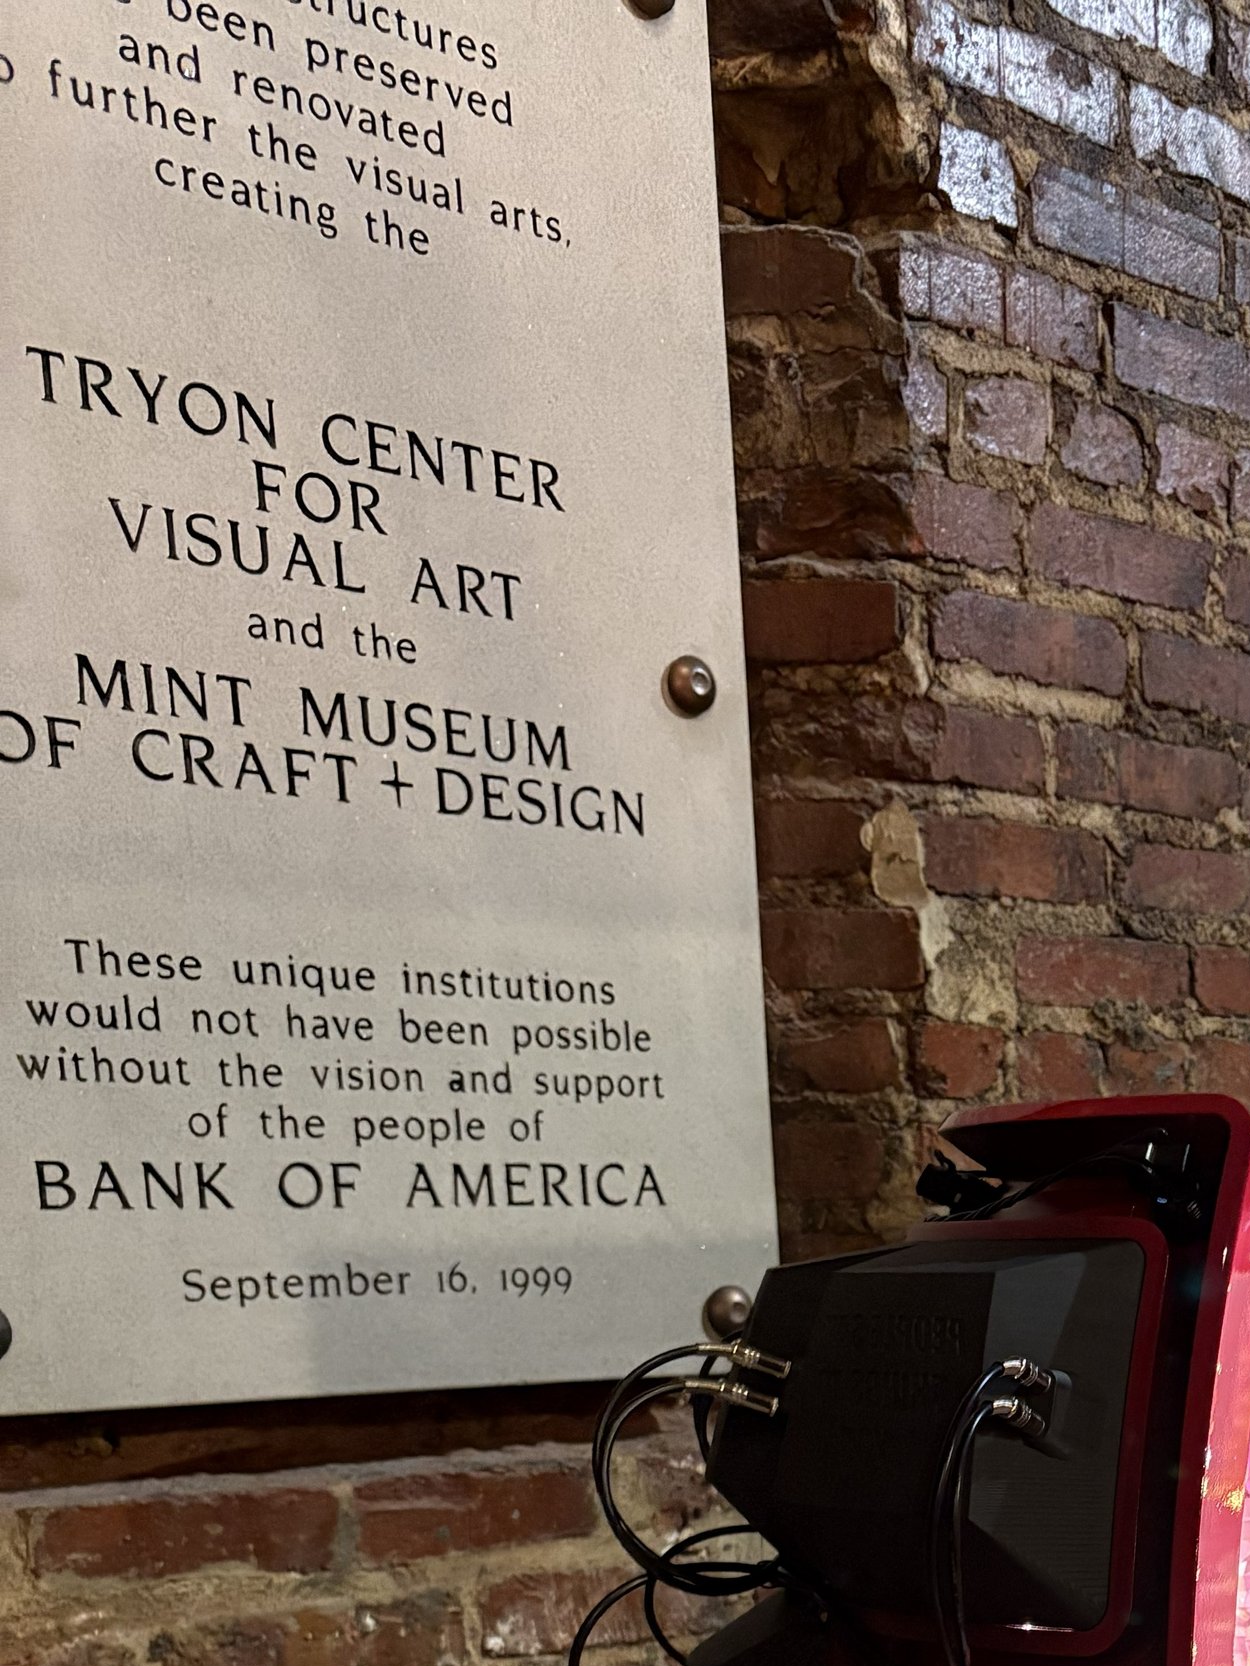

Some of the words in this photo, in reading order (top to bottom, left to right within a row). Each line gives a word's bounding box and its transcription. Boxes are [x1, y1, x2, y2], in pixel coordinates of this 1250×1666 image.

[166, 0, 276, 53] been
[305, 37, 514, 128] preserved
[287, 0, 498, 70] ructures
[118, 33, 202, 84] and
[232, 69, 446, 159] renovated
[47, 58, 218, 143] further
[247, 121, 318, 172] the
[345, 155, 464, 215] visual
[490, 199, 571, 249] arts,
[154, 157, 338, 240] creating
[364, 208, 430, 256] the
[25, 345, 277, 450] TRYON
[321, 413, 566, 513] CENTER
[251, 459, 389, 536] FOR
[107, 496, 366, 594] VISUAL
[409, 556, 522, 622] ART
[247, 612, 325, 650] and
[352, 621, 417, 665] the
[74, 652, 252, 728] MINT
[298, 686, 572, 772] MUSEUM
[0, 709, 82, 770] OF
[131, 728, 358, 804] CRAFT
[434, 766, 645, 838] DESIGN
[63, 938, 203, 982] These
[232, 954, 376, 998] unique
[401, 961, 616, 1006] institutions
[25, 993, 162, 1033] would
[191, 1007, 260, 1038] not
[286, 1003, 374, 1042] have
[398, 1007, 489, 1047] been
[512, 1017, 652, 1056] possible
[16, 1045, 191, 1087] without
[218, 1052, 283, 1089] the
[310, 1058, 424, 1093] vision
[447, 1061, 513, 1095] and
[534, 1072, 665, 1104] support
[187, 1102, 228, 1139] of
[259, 1104, 326, 1140] the
[353, 1107, 486, 1149] people
[509, 1109, 544, 1143] of
[34, 1160, 235, 1211] BANK
[277, 1161, 362, 1210] OF
[405, 1162, 667, 1208] AMERICA
[182, 1262, 411, 1308] September
[437, 1261, 477, 1294] 16,
[500, 1265, 572, 1298] 1999
